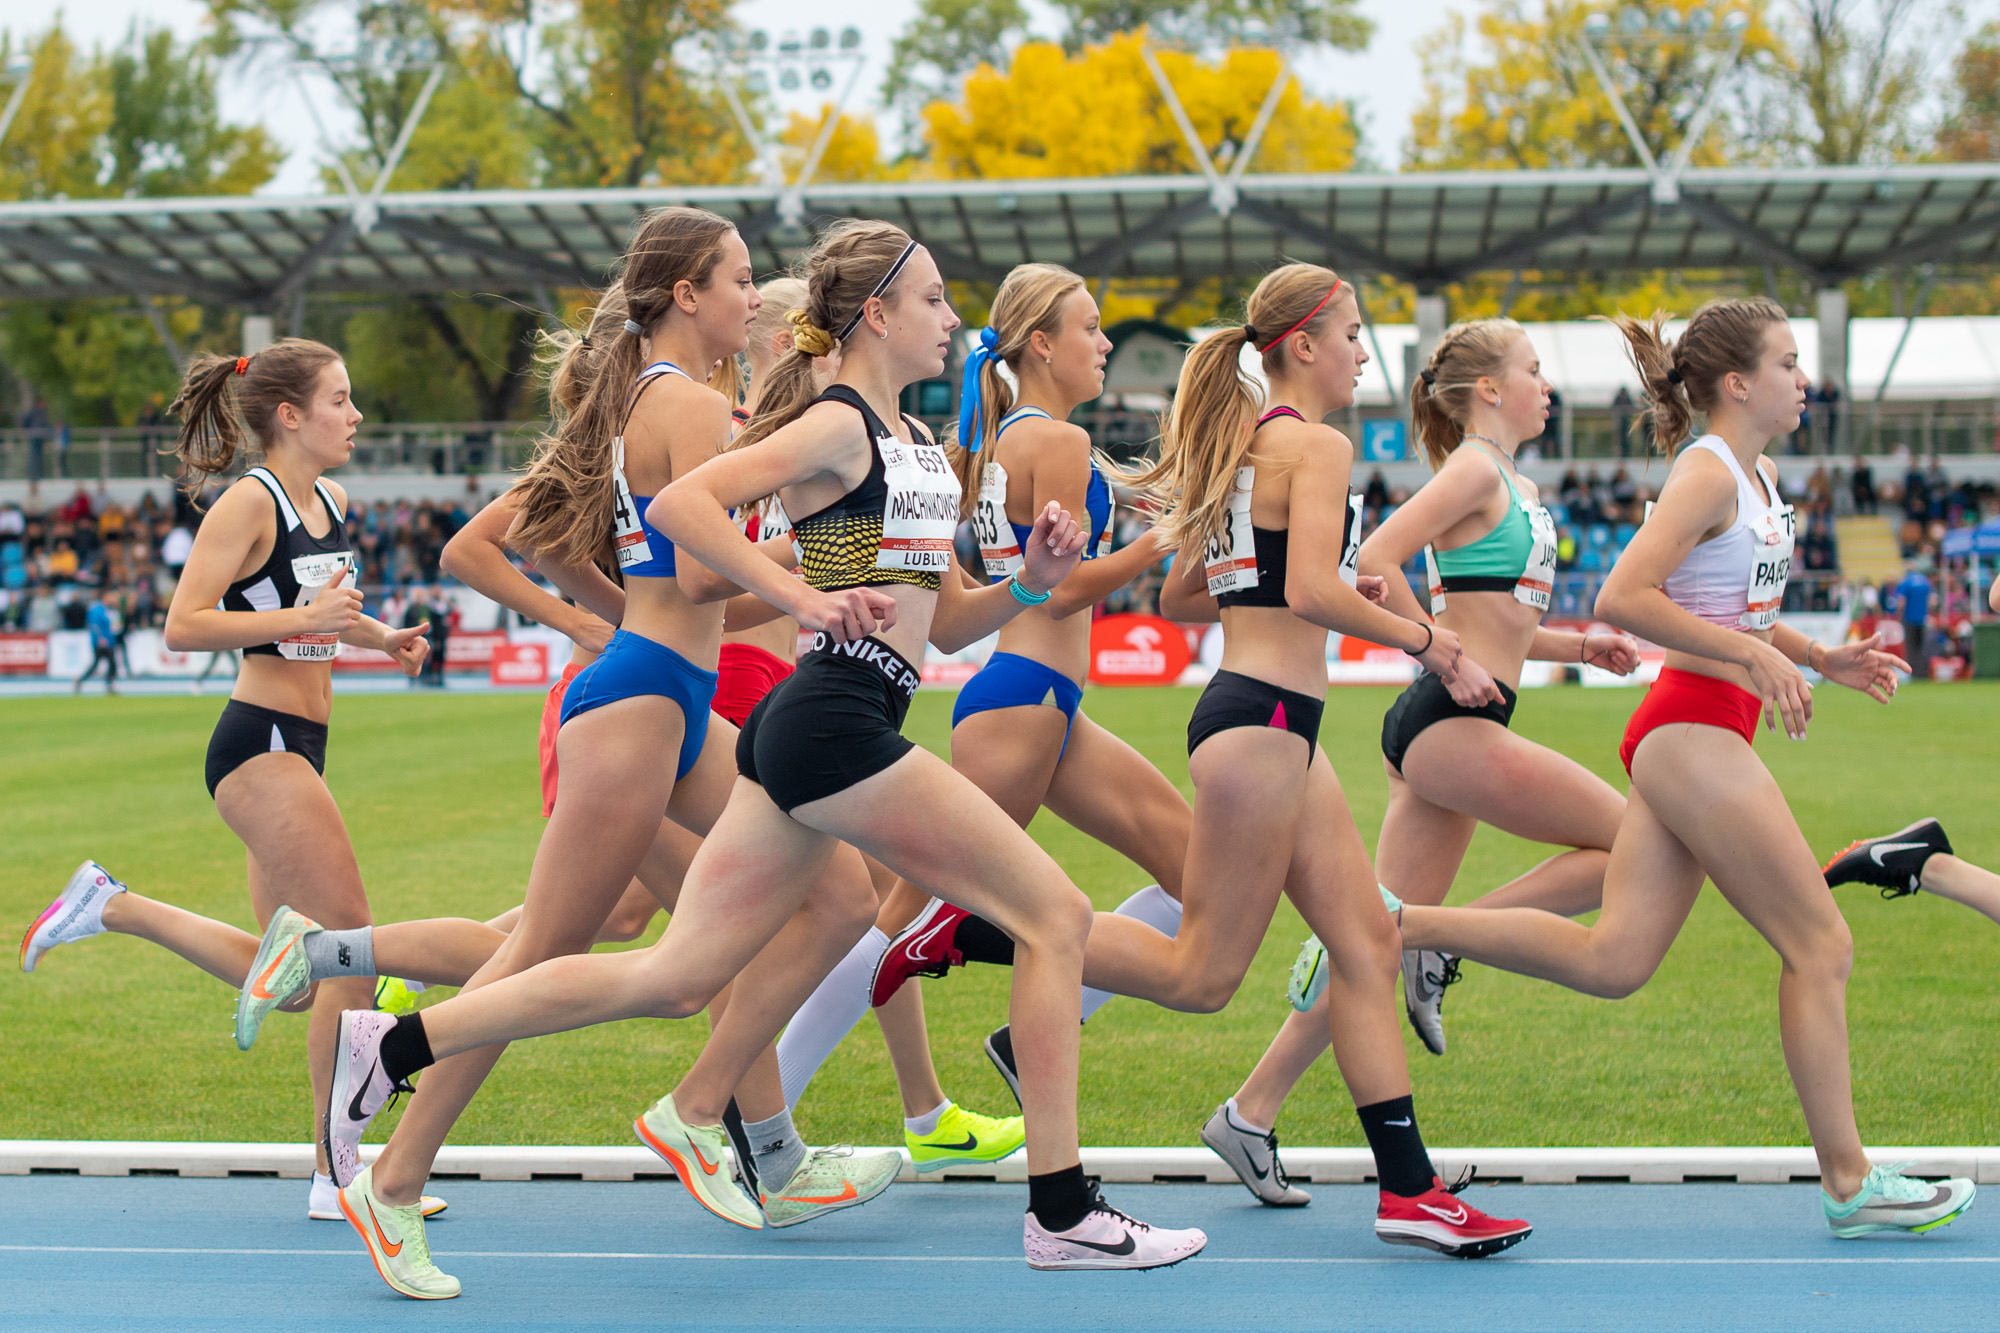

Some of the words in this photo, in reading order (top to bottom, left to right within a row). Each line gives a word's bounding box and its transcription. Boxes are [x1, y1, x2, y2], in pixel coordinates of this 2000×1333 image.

[1372, 428, 1396, 461] C
[914, 449, 947, 474] 659
[904, 552, 945, 566] LUBLIN
[297, 645, 329, 657] LUBLIN
[832, 639, 903, 681] NIKE
